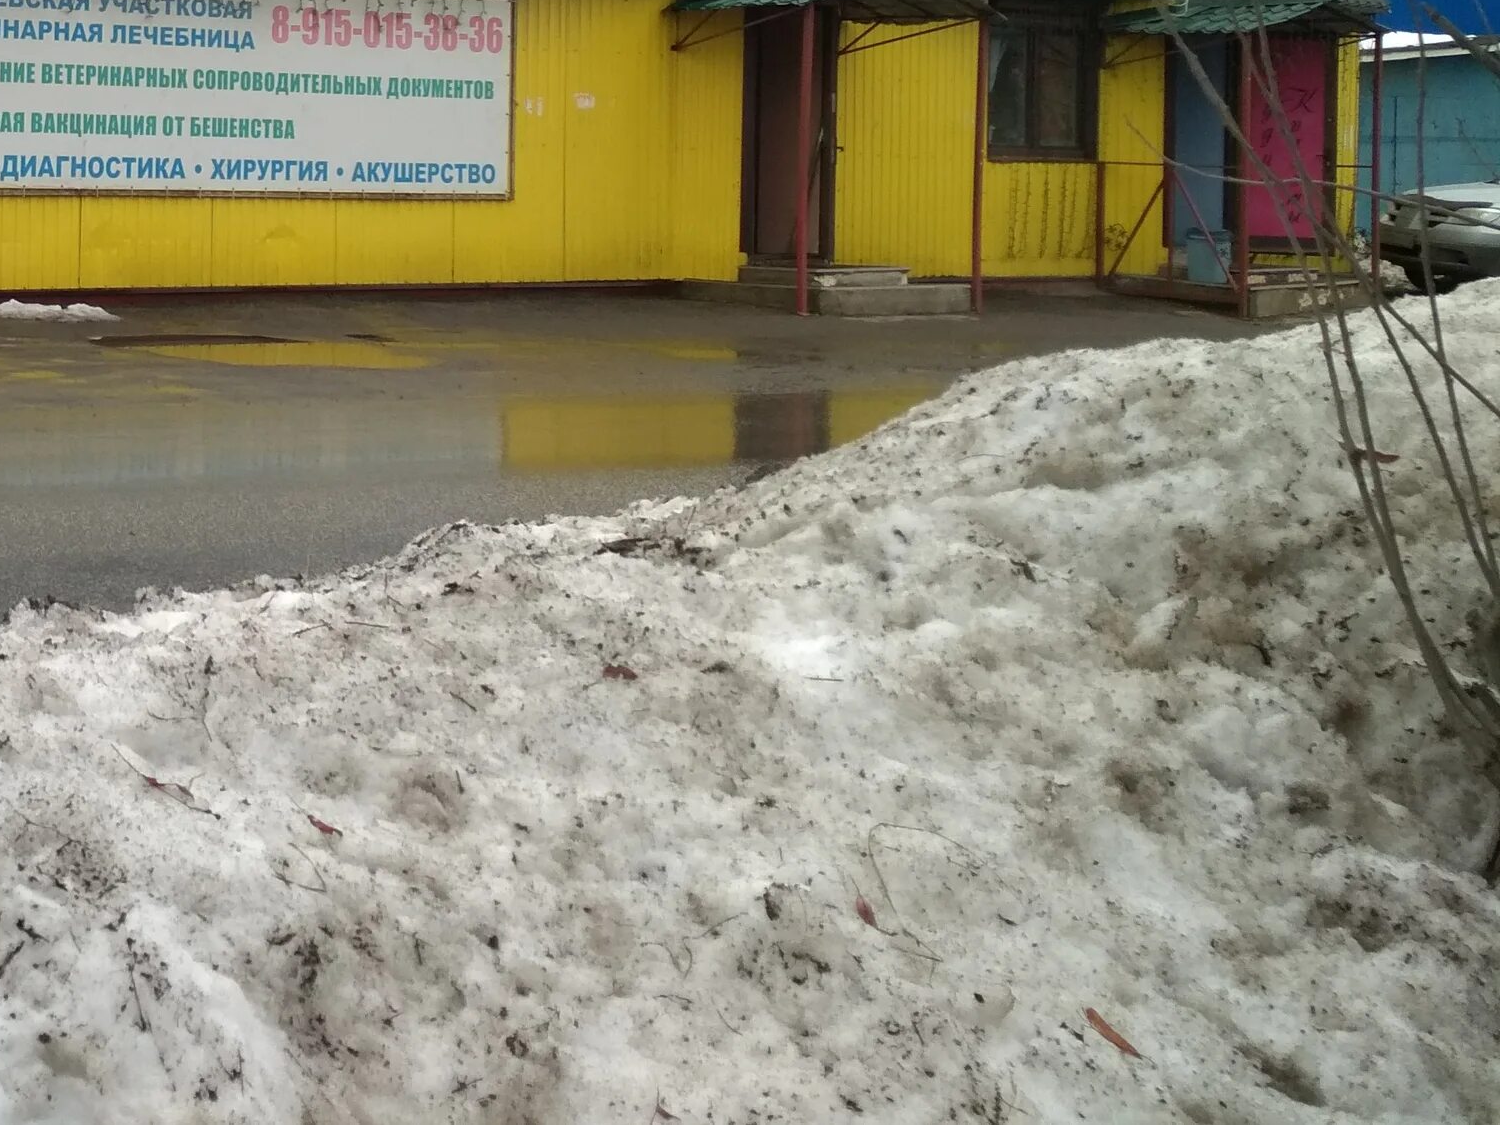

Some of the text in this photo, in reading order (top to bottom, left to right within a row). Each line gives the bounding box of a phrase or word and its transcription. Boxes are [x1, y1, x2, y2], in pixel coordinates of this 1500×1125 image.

[110, 23, 255, 53] ЛЕЧЕБНИЦА
[271, 5, 504, 54] 8-915-015-38-36
[41, 62, 188, 89] ВЕТЕРИНАРНЫХ
[193, 69, 382, 96] СОПРОВОДИТЕЛЬНЫХ
[386, 77, 495, 100] ДОКУМЕНТОВ
[31, 113, 157, 138] ВАКЦИНАЦИЯ
[162, 115, 185, 136] ОТ
[190, 116, 295, 139] БЕШЕНСТВА
[0, 155, 185, 182] ДИАГНОСТИКА
[211, 158, 329, 182] ХИРУРГИЯ
[351, 161, 496, 184] АКУШЕРСТВО
